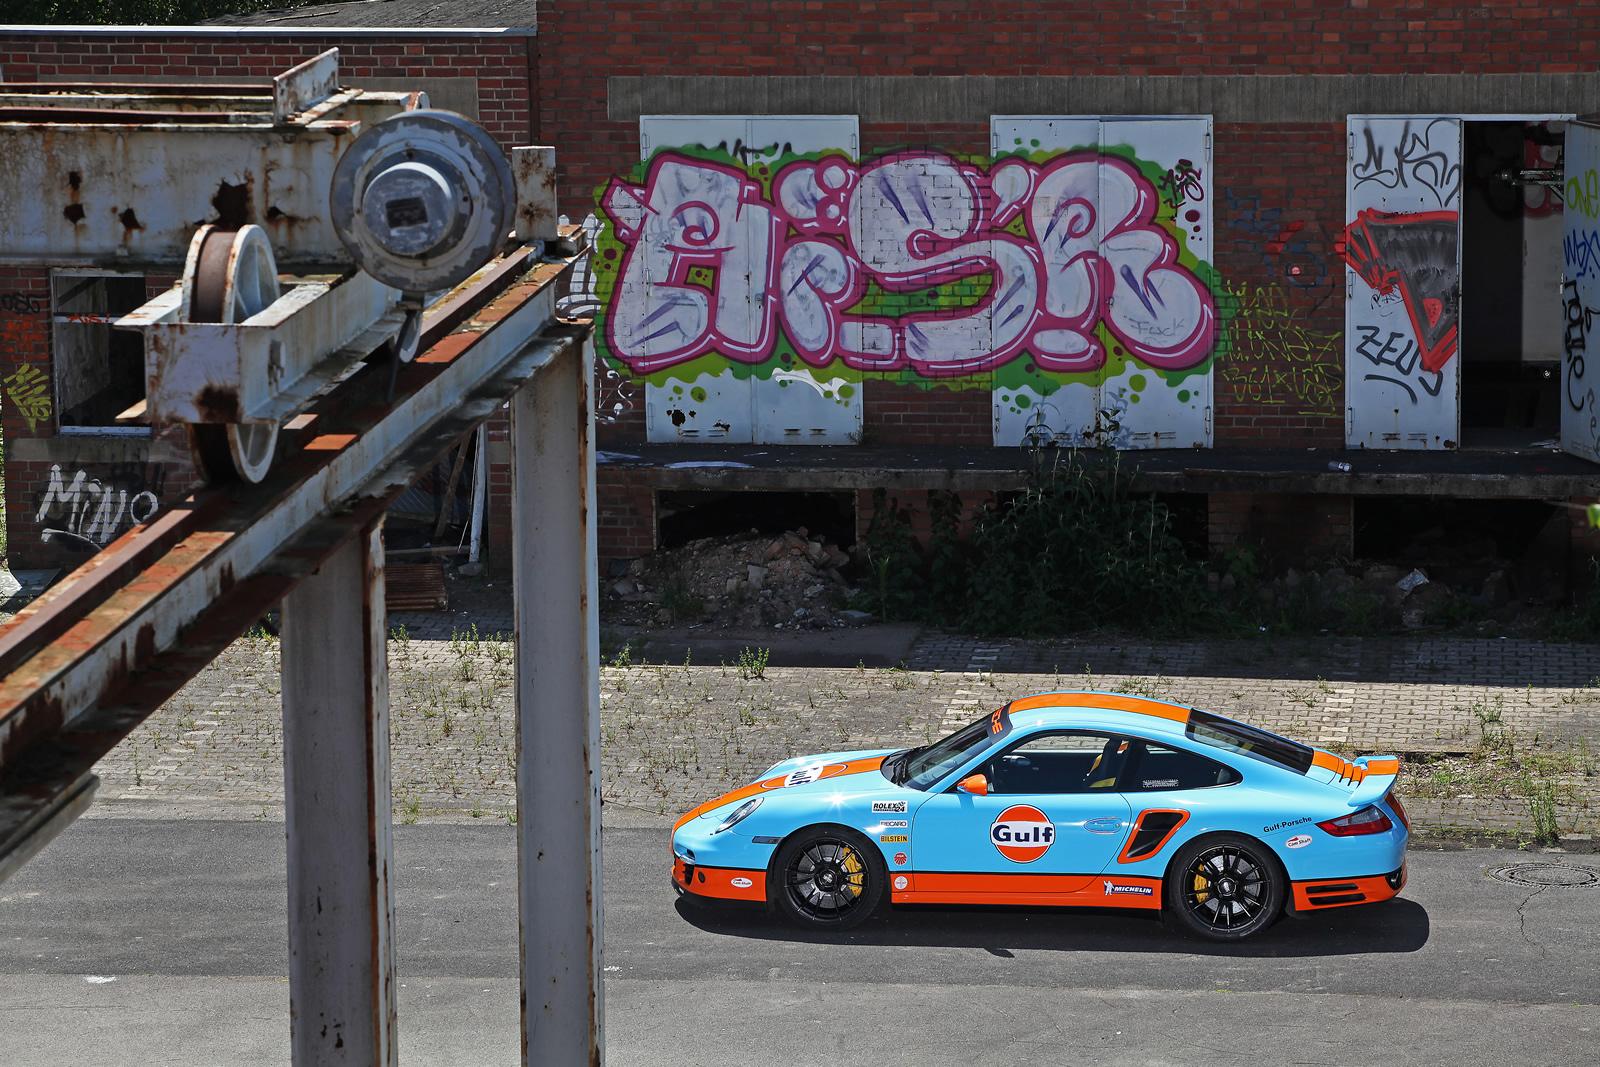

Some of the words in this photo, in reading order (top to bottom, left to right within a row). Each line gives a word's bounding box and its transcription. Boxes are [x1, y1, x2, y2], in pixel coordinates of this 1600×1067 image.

[1263, 816, 1313, 833] Gulf-Porsche
[992, 824, 1054, 843] Gulf
[1113, 886, 1152, 894] MICHELIN
